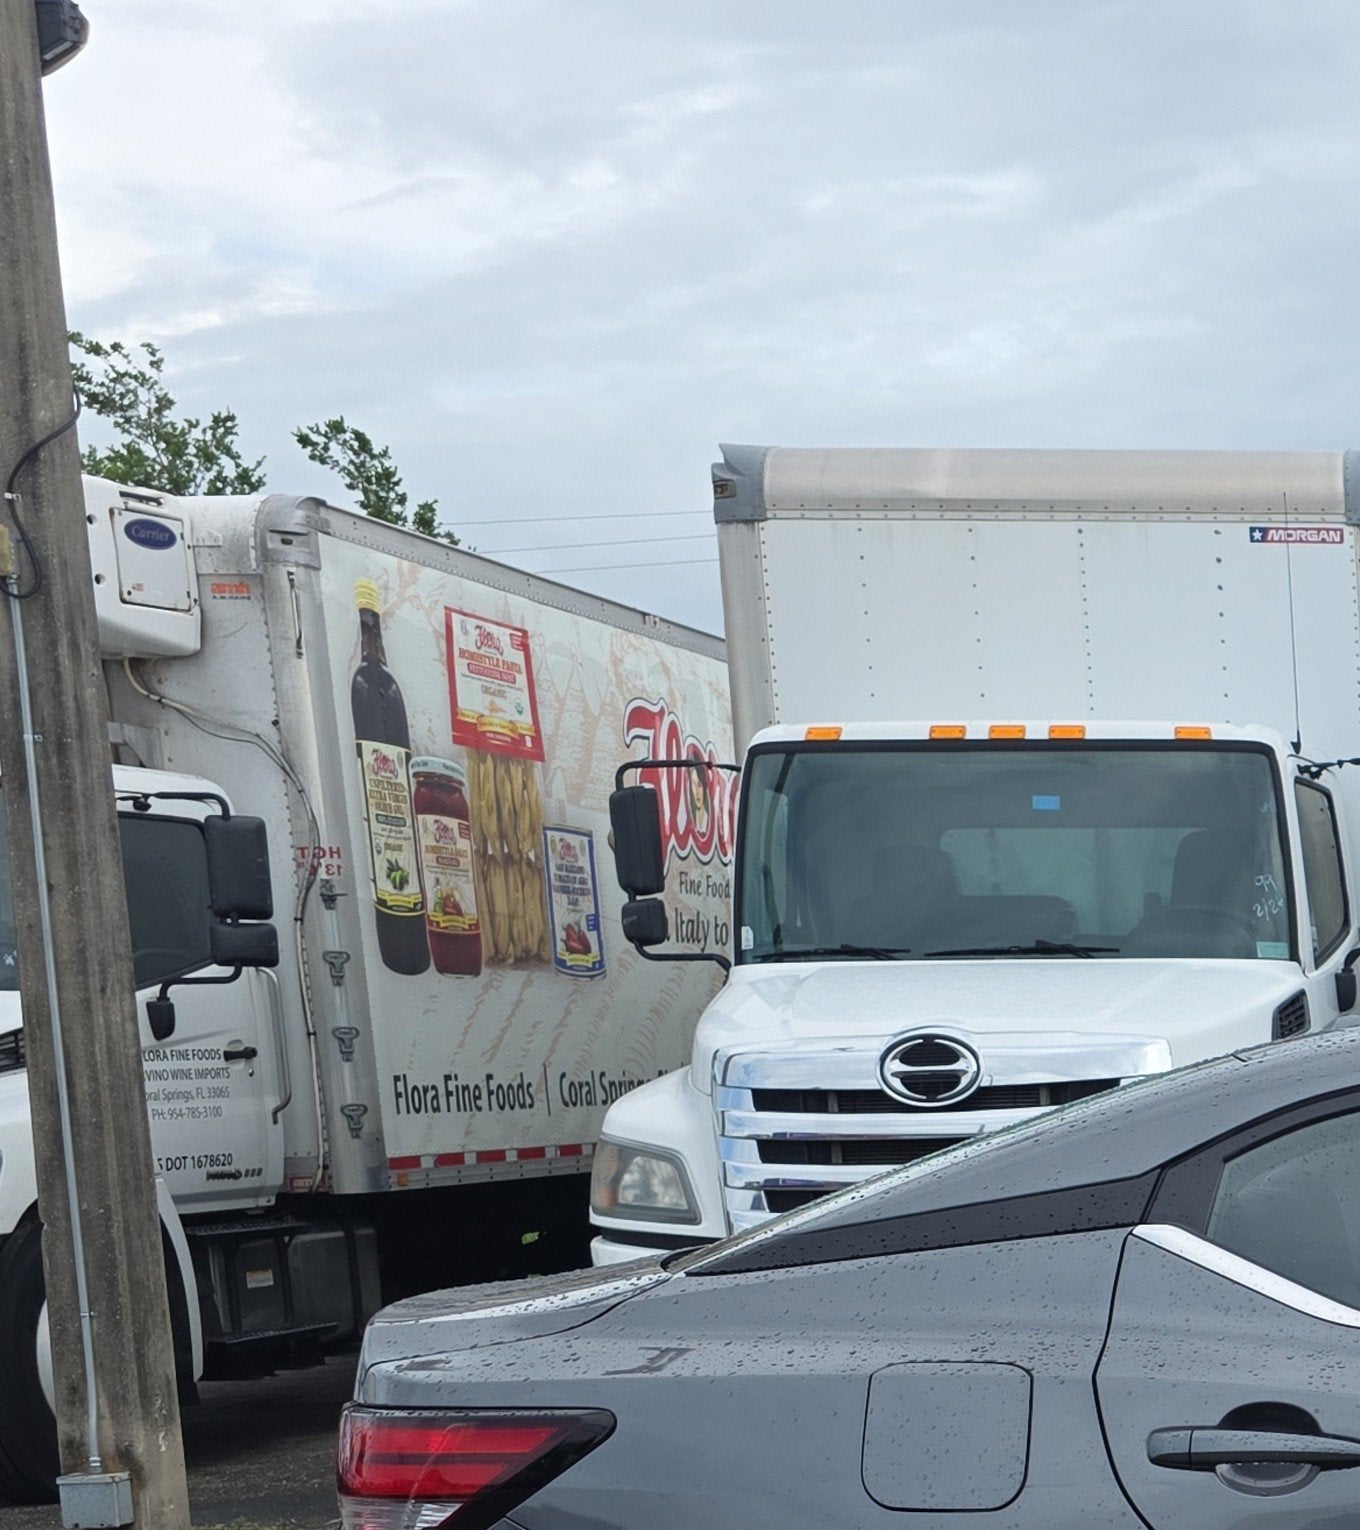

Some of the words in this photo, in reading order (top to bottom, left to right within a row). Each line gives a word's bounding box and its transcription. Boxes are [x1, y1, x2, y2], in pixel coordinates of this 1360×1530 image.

[130, 524, 171, 542] Carrier
[1267, 529, 1341, 542] MORGAN
[624, 697, 740, 878] Flor
[678, 871, 702, 896] Fine
[706, 874, 731, 899] Food
[674, 906, 710, 950] Italy
[714, 915, 730, 947] to
[143, 1050, 169, 1062] LORA
[170, 1049, 191, 1061] FINE
[192, 1048, 222, 1061] FOODS
[145, 1068, 169, 1082] VINO
[170, 1067, 194, 1081] WINE
[194, 1066, 231, 1080] IMPORTS
[145, 1088, 161, 1101] oral
[196, 1088, 206, 1100] FL
[207, 1086, 230, 1099] 33065
[392, 1073, 442, 1115] Flora
[443, 1072, 483, 1114] Fine
[485, 1071, 535, 1112] Foods
[559, 1069, 598, 1108] Coral
[151, 1108, 167, 1121] PH:
[168, 1105, 223, 1120] 954-785-3100
[165, 1155, 189, 1172] DOT
[191, 1153, 234, 1170] 1678620
